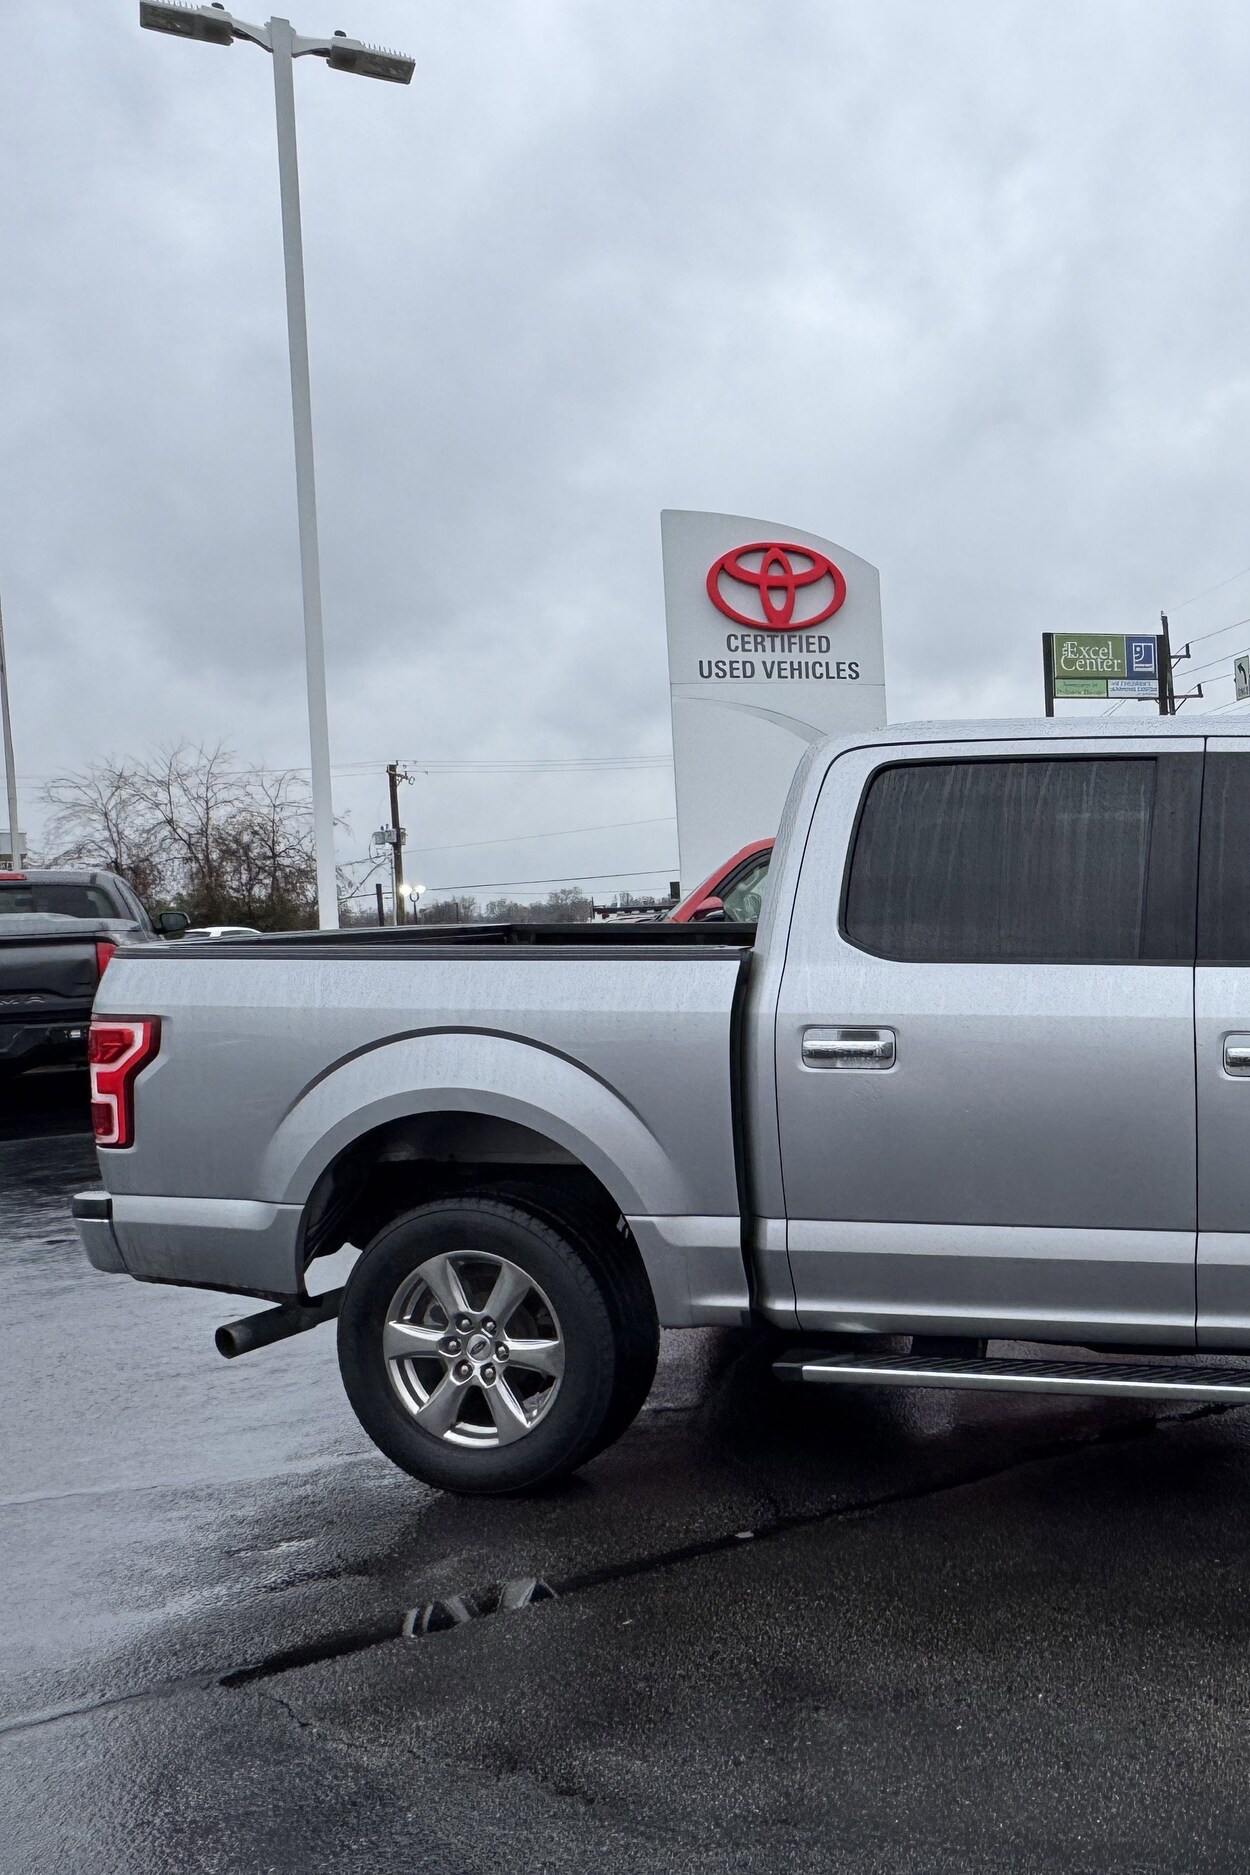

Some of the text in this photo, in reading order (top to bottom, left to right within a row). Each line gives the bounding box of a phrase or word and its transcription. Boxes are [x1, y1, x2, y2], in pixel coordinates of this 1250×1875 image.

[726, 633, 831, 654] CERTIFIED
[1066, 641, 1114, 659] Excel
[698, 660, 860, 681] USED VEHICLES
[1061, 656, 1121, 672] Center
